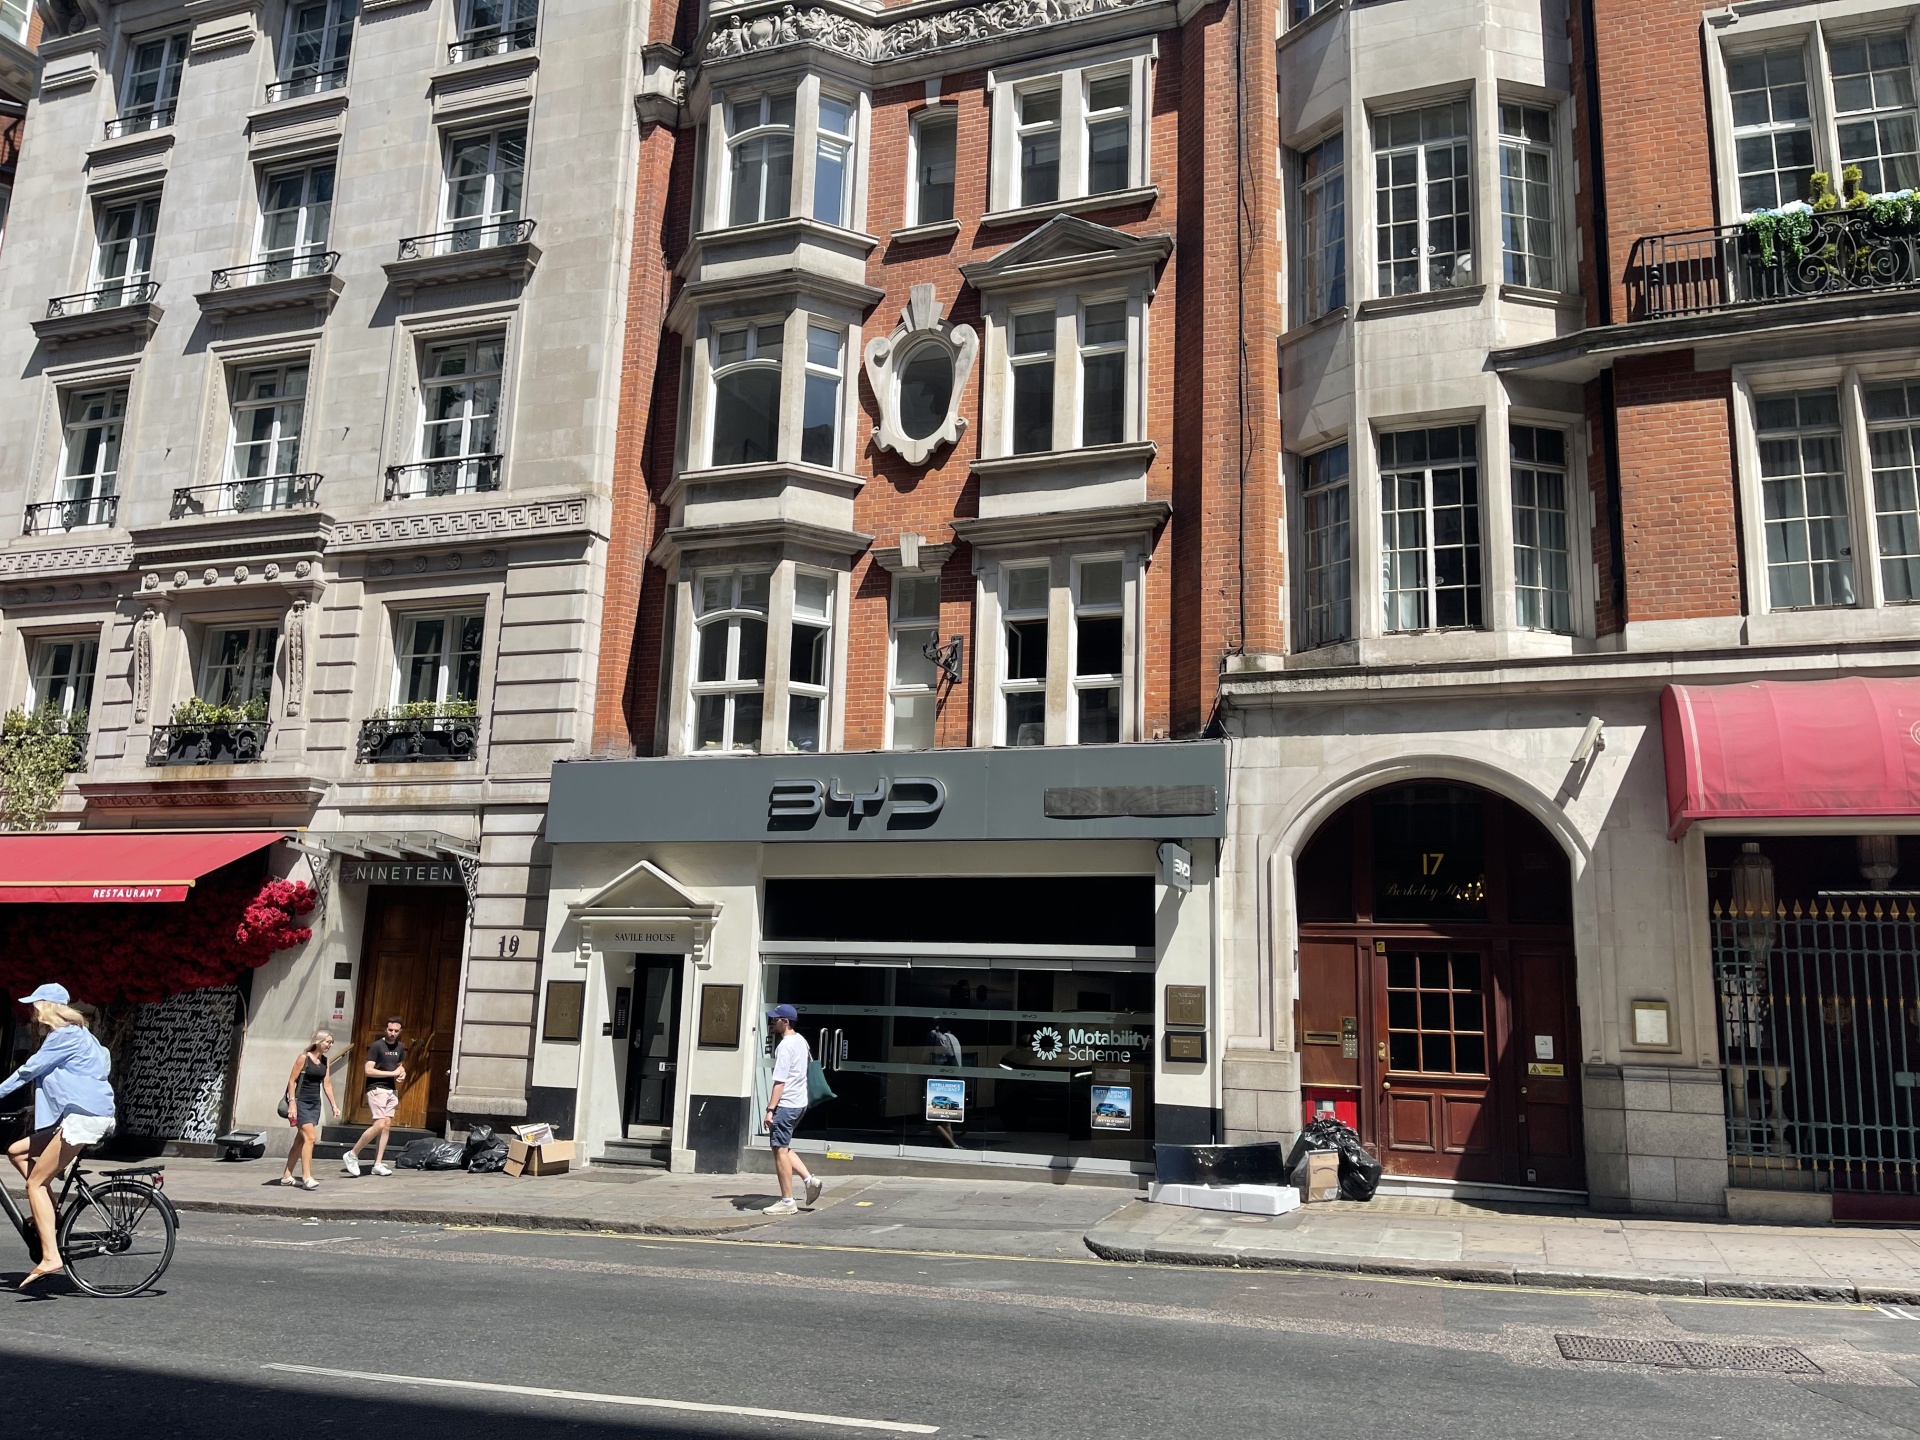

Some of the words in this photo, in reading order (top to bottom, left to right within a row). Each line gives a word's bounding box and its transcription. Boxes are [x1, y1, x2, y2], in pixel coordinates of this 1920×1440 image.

[771, 776, 947, 816] BYD
[356, 866, 453, 880] NINETEEN
[1423, 853, 1444, 875] 17
[92, 888, 162, 899] RESTAURANT
[1385, 883, 1438, 901] Berkeley
[499, 935, 520, 956] 19
[615, 932, 643, 942] SAVILE
[645, 933, 676, 942] HOUSE
[1179, 1006, 1193, 1019] 18
[1068, 1028, 1151, 1051] Motability
[1068, 1045, 1131, 1063] Scheme
